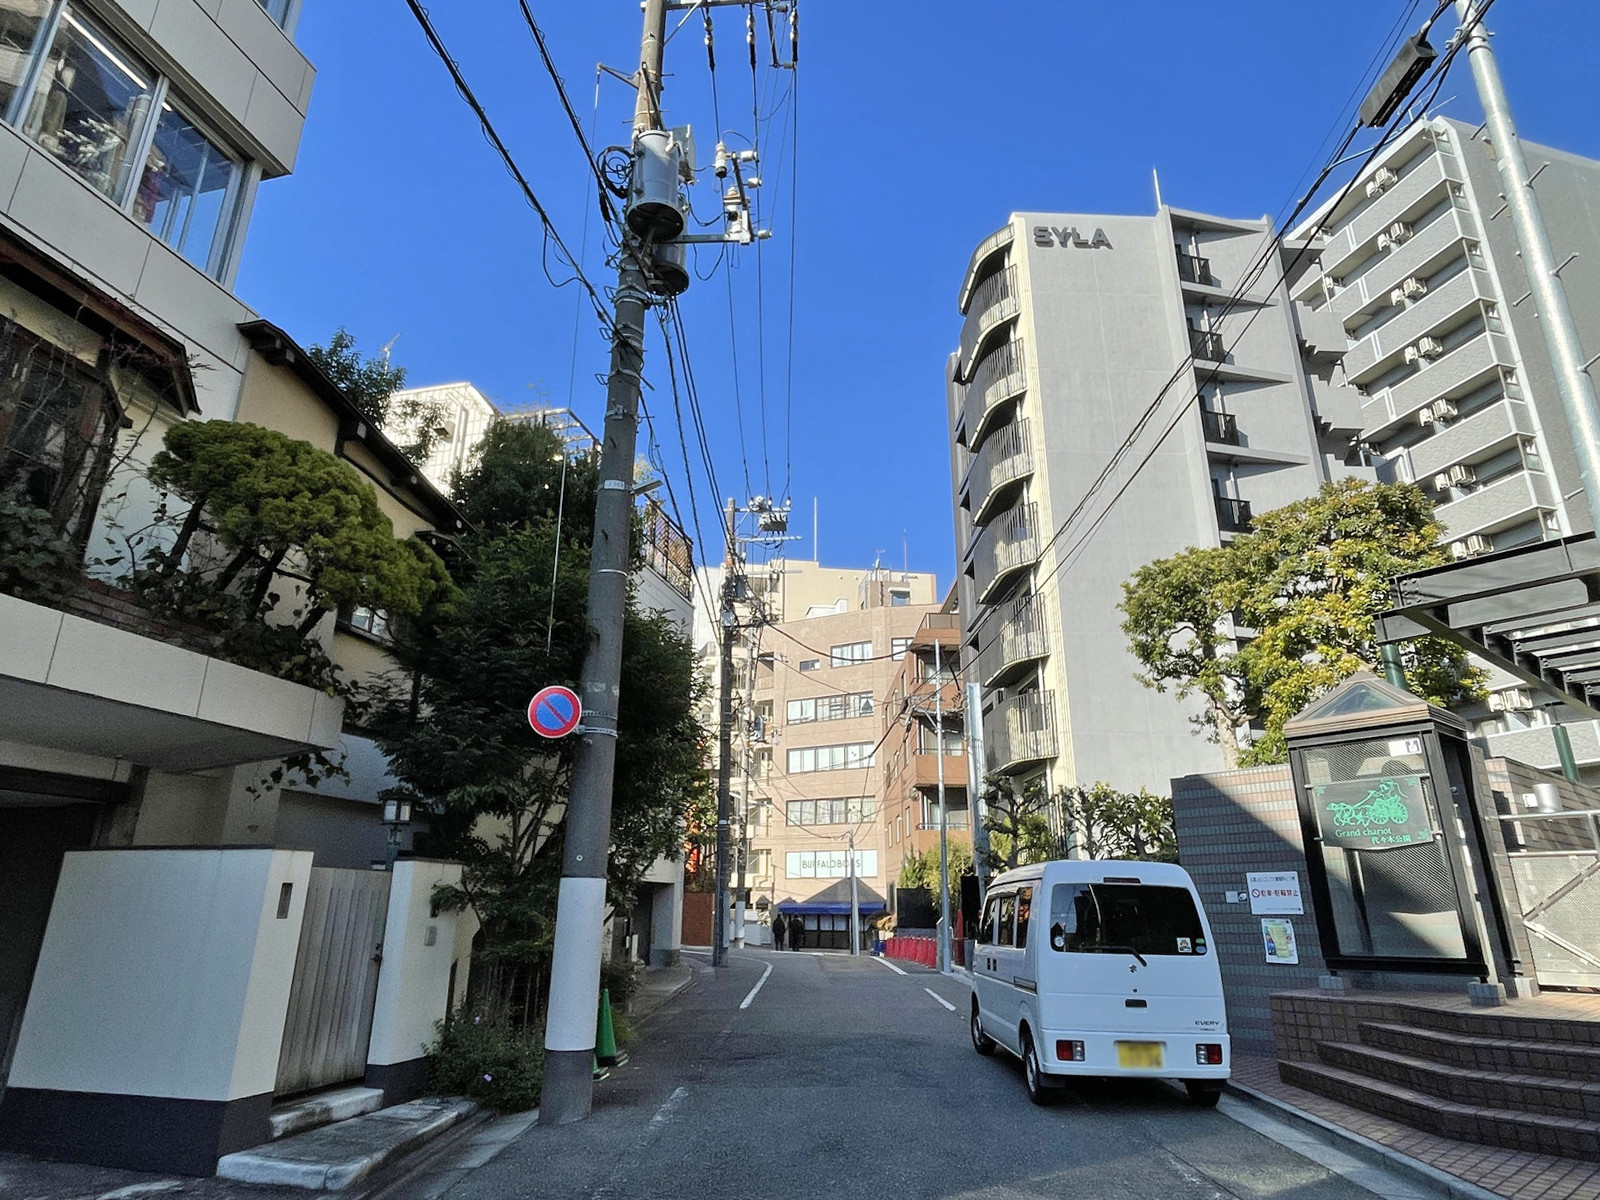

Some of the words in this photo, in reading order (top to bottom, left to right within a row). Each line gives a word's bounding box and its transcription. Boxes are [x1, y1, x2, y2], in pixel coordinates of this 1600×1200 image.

[1033, 226, 1113, 250] SYLA
[1335, 828, 1360, 838] Grand
[1362, 827, 1392, 837] chariot
[1371, 835, 1412, 845] 代々木公園
[802, 859, 861, 869] BUFFALOBOS
